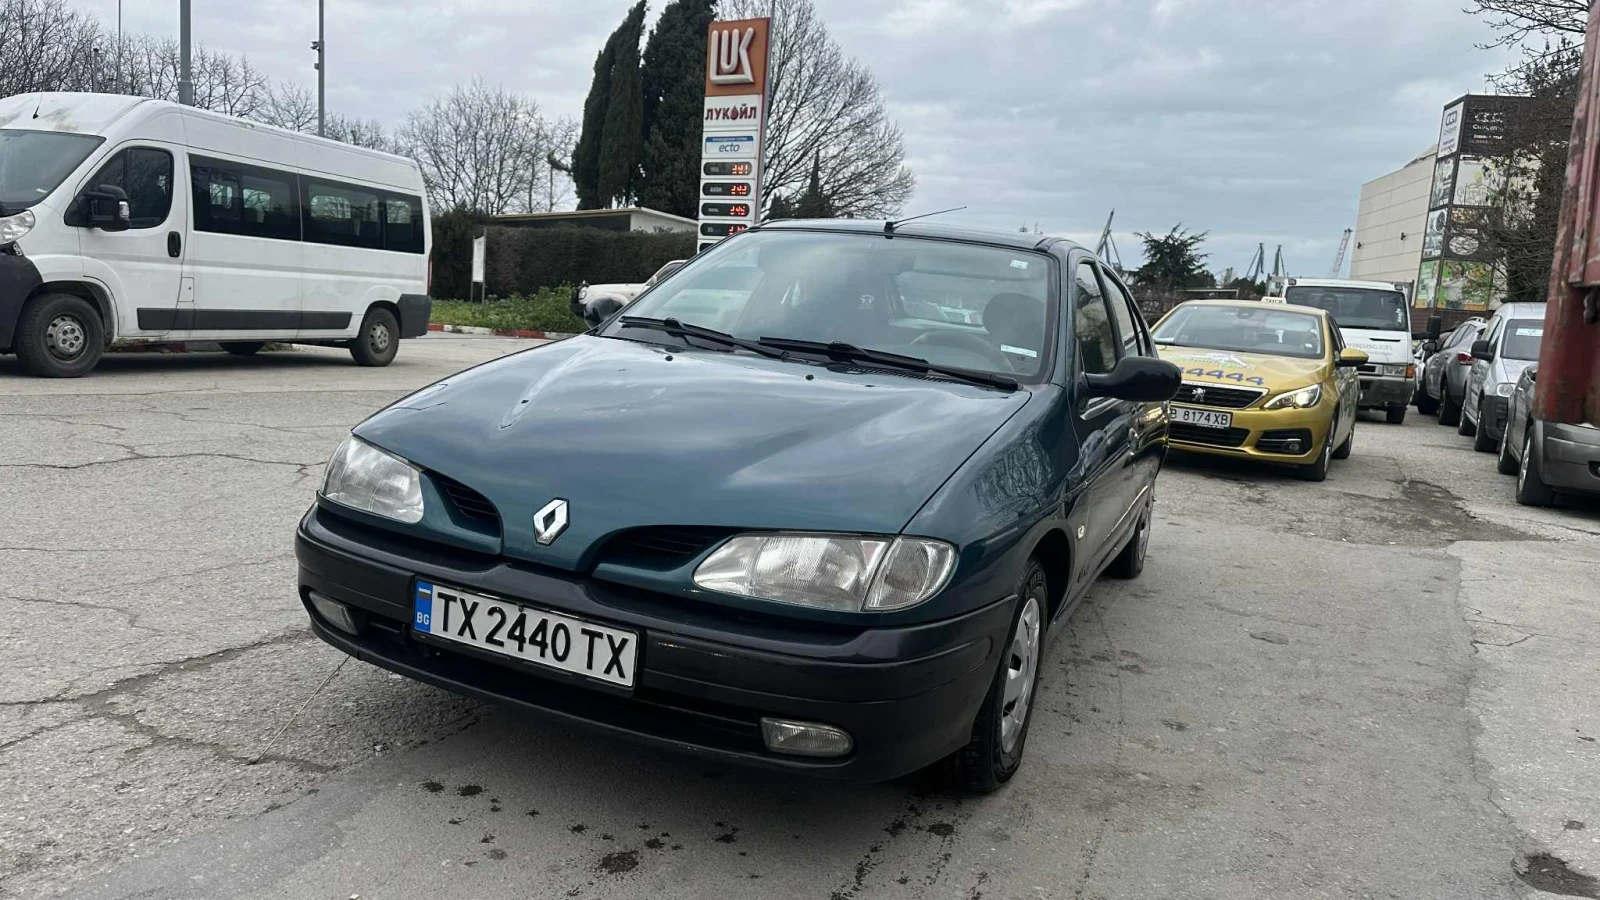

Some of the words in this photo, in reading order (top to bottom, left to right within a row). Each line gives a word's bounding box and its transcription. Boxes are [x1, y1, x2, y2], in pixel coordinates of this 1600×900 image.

[719, 143, 740, 153] ecto
[1183, 410, 1211, 424] 8174
[1213, 413, 1229, 426] XB
[416, 611, 430, 625] BG
[437, 592, 479, 639] TX
[485, 606, 571, 662] 2440
[580, 628, 629, 678] TX
